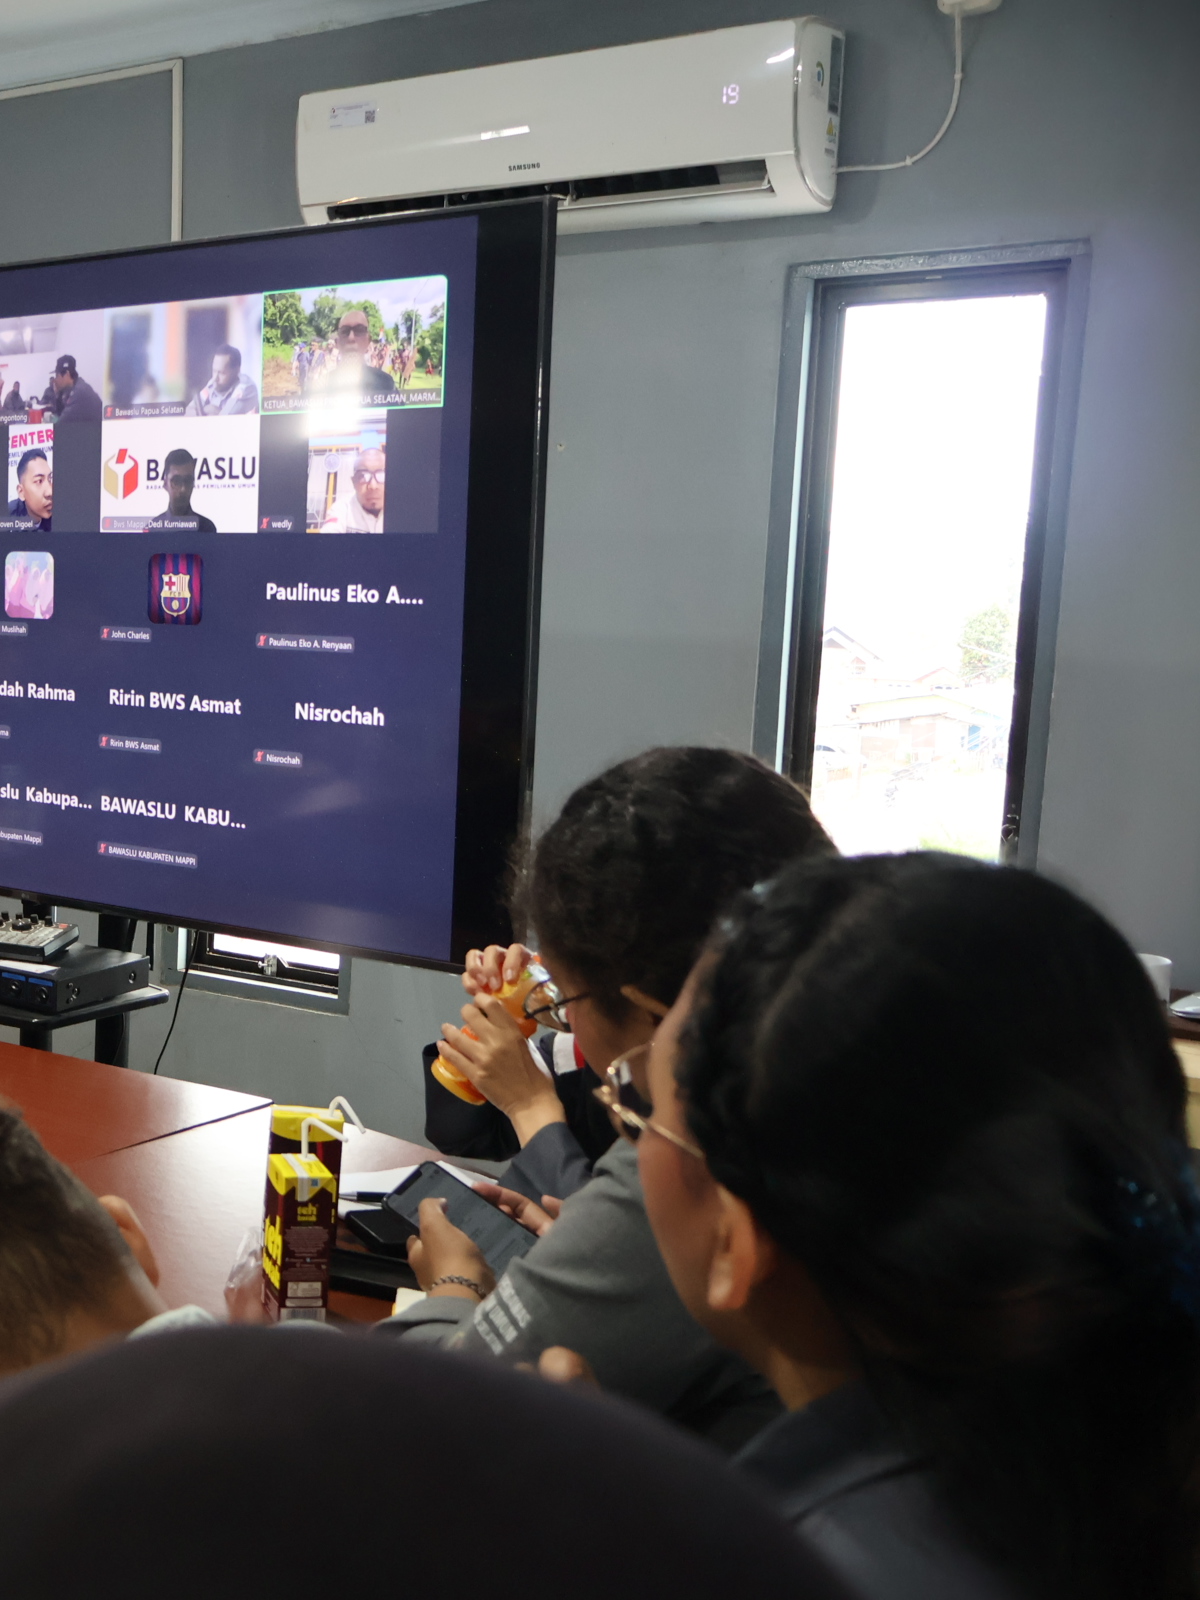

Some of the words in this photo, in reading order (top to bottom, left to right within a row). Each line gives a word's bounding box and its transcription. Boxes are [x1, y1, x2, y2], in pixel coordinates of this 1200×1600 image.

[722, 84, 740, 104] 19
[508, 162, 540, 172] SAMSUNG
[115, 408, 140, 416] Bawaslu
[140, 408, 160, 416] Papua
[160, 406, 184, 414] Selatan
[9, 429, 54, 449] ENTER
[14, 520, 34, 530] Digoel
[164, 520, 197, 528] Kurniawan
[272, 520, 292, 530] wedly
[266, 582, 340, 602] Paulinus
[346, 584, 380, 604] Eko
[2, 624, 27, 634] Muslihah
[111, 630, 126, 639] John
[127, 630, 150, 640] Charles
[268, 638, 298, 648] Paulinus
[298, 639, 312, 648] Eko
[312, 640, 320, 648] A.
[322, 640, 352, 652] Renyaan
[27, 682, 76, 702] Rahma
[109, 688, 146, 708] Ririn
[149, 692, 186, 710] BWS
[189, 694, 242, 715] Asmat
[294, 702, 385, 726] Nisrochah
[110, 738, 124, 748] Ririn
[124, 740, 140, 750] BWS
[140, 741, 160, 752] Asmat
[266, 753, 301, 765] Nisrochah
[26, 786, 92, 810] Kabupa...
[100, 795, 177, 820] BAWASLU
[184, 804, 246, 829] KABU...
[24, 834, 42, 845] Mappi
[108, 846, 138, 858] BAWASLU
[138, 850, 174, 863] KABUPATEN
[175, 855, 196, 866] MAPPI
